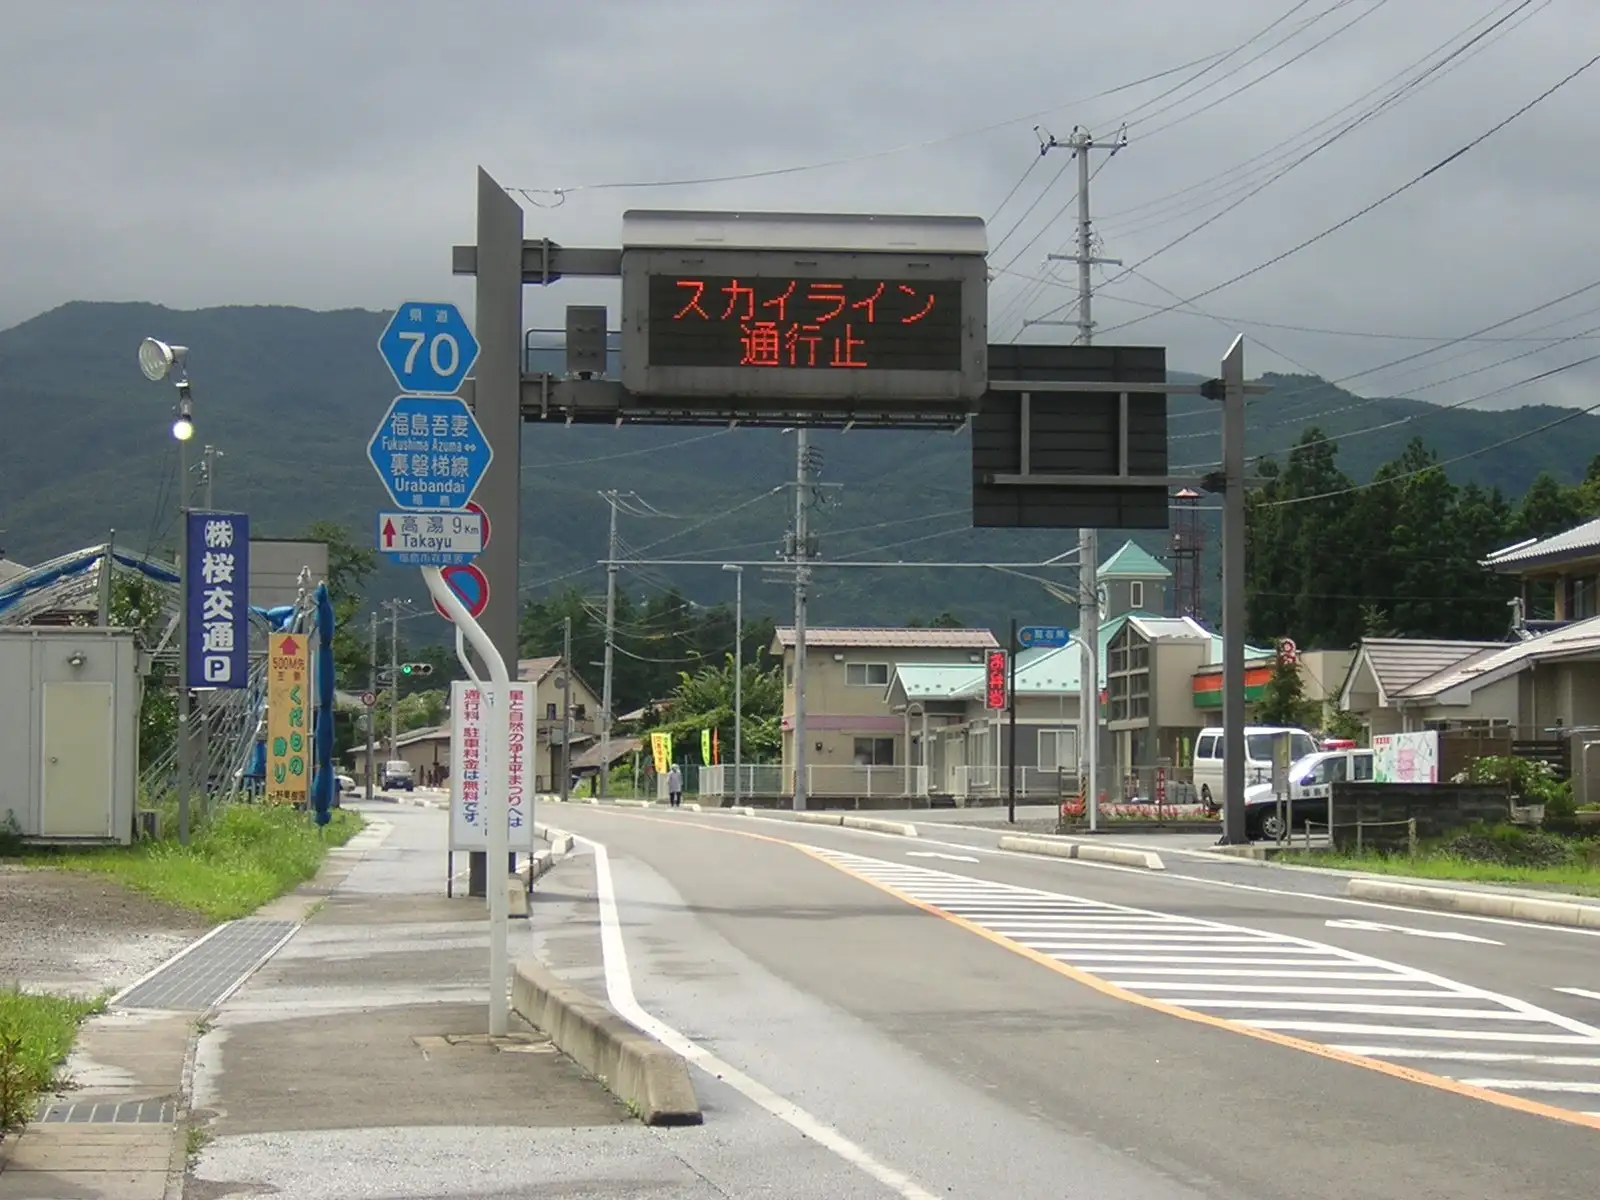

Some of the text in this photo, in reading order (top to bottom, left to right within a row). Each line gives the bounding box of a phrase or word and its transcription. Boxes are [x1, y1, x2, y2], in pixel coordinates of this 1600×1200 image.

[673, 279, 935, 324] スカイライン
[398, 331, 461, 378] 70
[739, 321, 868, 368] 通行止
[390, 412, 469, 438] 福島吾妻
[381, 436, 463, 454] Fukushima Azuma
[390, 453, 469, 478] 裏磐梯線
[395, 477, 465, 493] Urabandai
[401, 515, 444, 533] 高湯
[401, 533, 452, 552] Takayu
[989, 653, 1004, 707] お弁当
